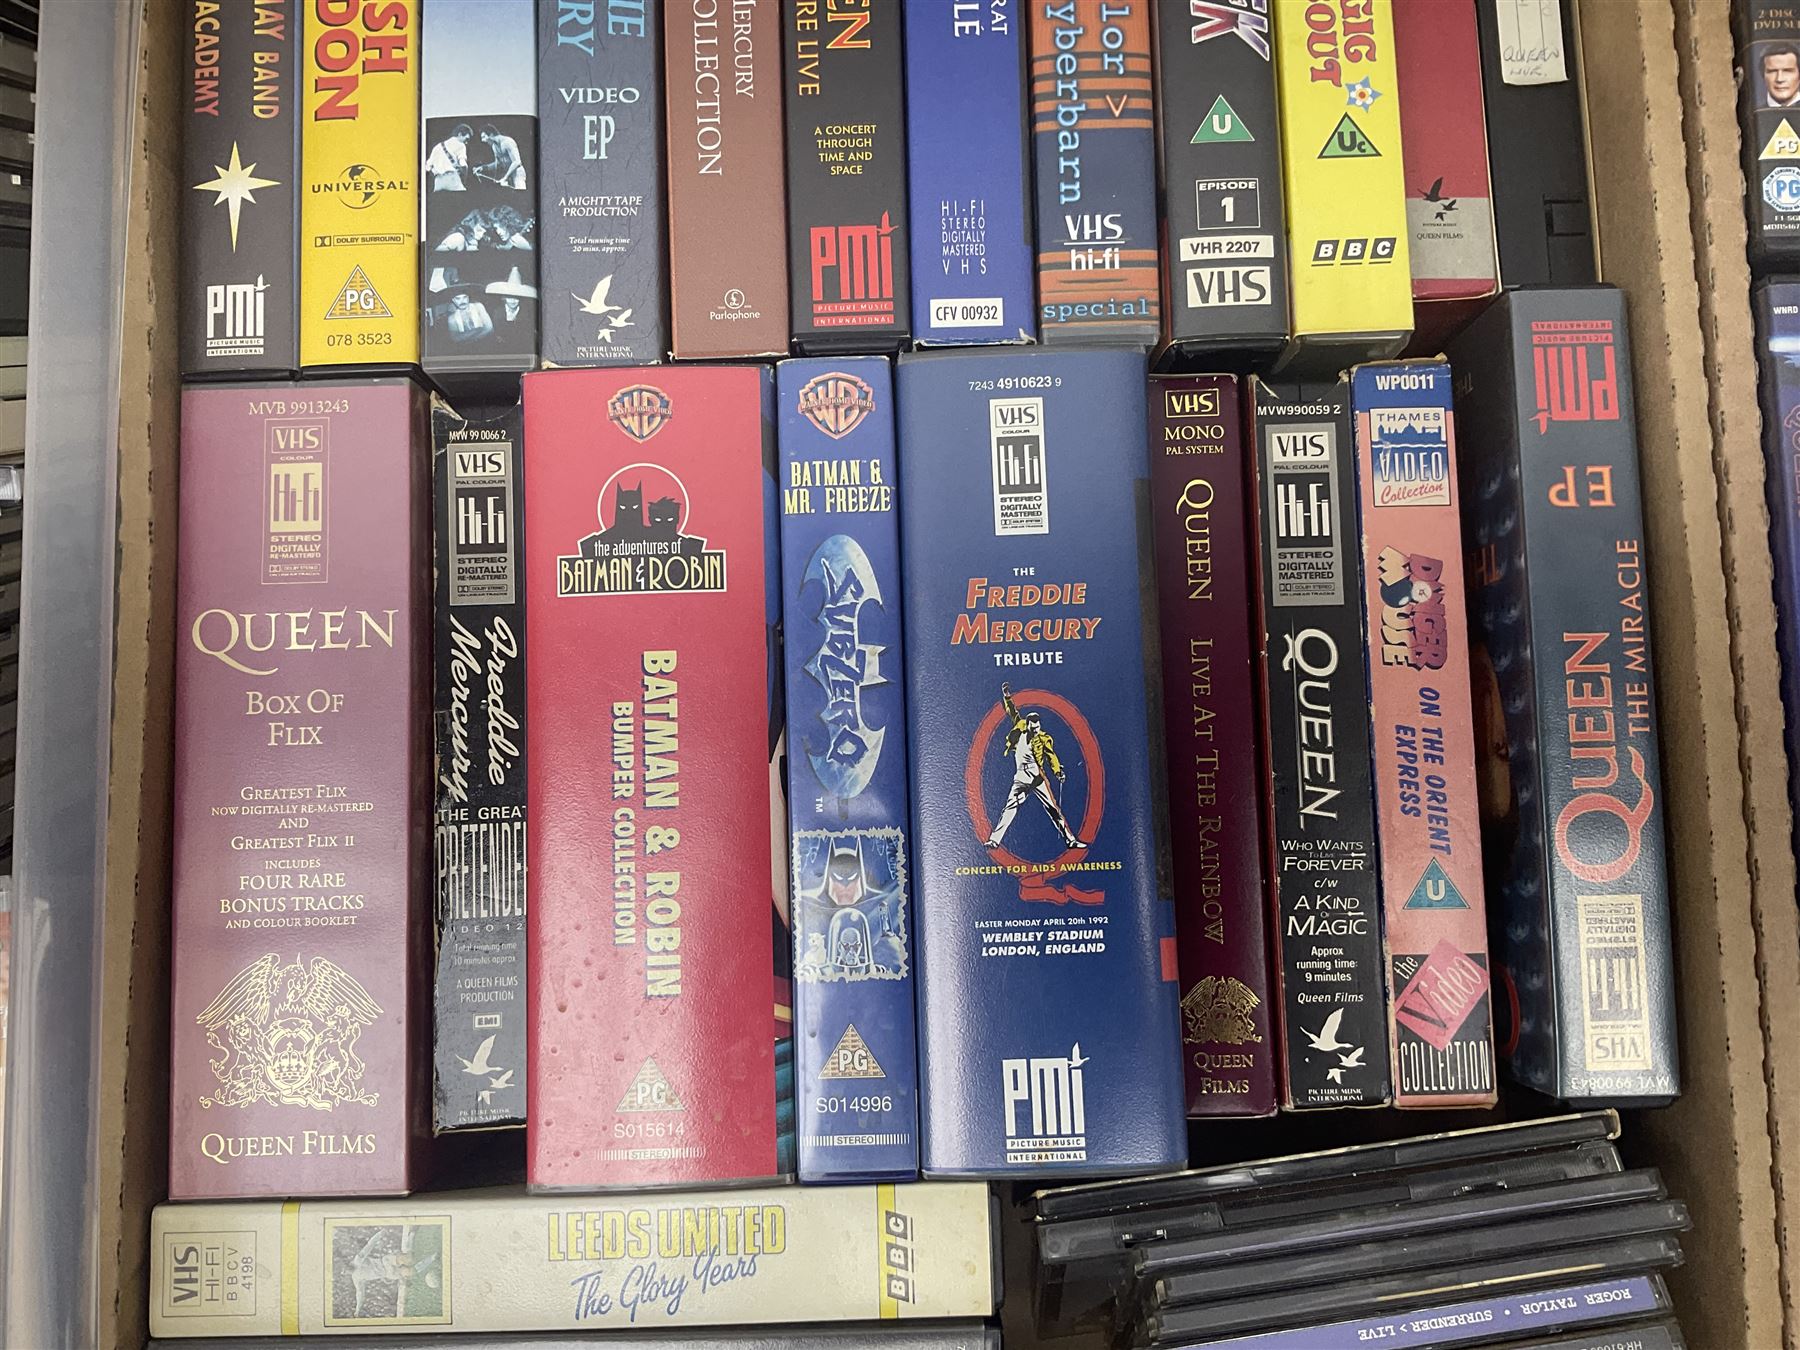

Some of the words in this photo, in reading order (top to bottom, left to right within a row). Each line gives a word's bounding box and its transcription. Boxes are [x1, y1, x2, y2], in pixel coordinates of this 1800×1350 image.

[194, 1, 220, 117] ACADEMY
[797, 40, 820, 96] LIVE
[253, 52, 280, 119] BAND
[558, 88, 640, 103] VIDEO
[814, 126, 822, 136] A
[826, 125, 877, 135] CONCERT
[1212, 114, 1232, 134] U
[583, 115, 616, 160] EP
[817, 138, 872, 148] THROUGH
[819, 152, 844, 162] TIME
[848, 152, 872, 161] AND
[830, 165, 863, 175] SPACE
[312, 180, 408, 194] UNIVERSAL
[1198, 182, 1256, 191] EPISODE
[559, 197, 567, 206] A
[567, 196, 613, 206] MIGHTY
[614, 196, 643, 206] TAPE
[941, 200, 984, 216] HI-FI
[1220, 196, 1235, 223] 1
[563, 206, 638, 217] PRODUCTION
[941, 217, 985, 230] STEREO
[1065, 214, 1123, 241] VHS
[942, 230, 985, 242] DIGITALLY
[942, 244, 986, 256] MASTERED
[1190, 242, 1222, 255] VHR
[1226, 241, 1260, 254] 2207
[1070, 247, 1120, 271] hi-fi
[345, 289, 375, 311] PG
[710, 310, 760, 322] Parlophone
[936, 307, 958, 321] CFV
[961, 306, 998, 320] 00932
[1043, 298, 1149, 322] special
[327, 335, 353, 347] 078
[357, 333, 392, 345] 3523
[968, 381, 994, 391] 7243
[996, 376, 1052, 389] 4910623
[1055, 378, 1062, 387] 9
[1376, 374, 1434, 391] WP0011
[249, 402, 286, 415] MVB
[290, 399, 350, 414] 9913243
[1170, 393, 1214, 414] VHS
[1377, 412, 1441, 422] THAMES
[1164, 425, 1225, 441] MONO
[1166, 446, 1184, 455] PAL
[1185, 445, 1224, 455] SYSTEM
[790, 460, 861, 487] BATMAN
[1379, 451, 1443, 482] VIDEO
[1380, 482, 1444, 505] Collection
[1548, 465, 1616, 508] EP
[784, 488, 816, 515] MR.
[825, 486, 891, 513] FREEZE
[594, 540, 610, 557] the
[612, 539, 669, 556] adventures
[671, 538, 682, 554] of
[1176, 478, 1214, 601] QUEEN
[560, 557, 632, 593] BATMAN
[635, 557, 645, 590] &
[648, 555, 721, 590] ROBIN
[1013, 567, 1035, 576] THE
[966, 578, 1087, 609] FREDDIE
[1616, 539, 1648, 673] MIRACLE
[950, 612, 1102, 645] MERCURY
[192, 606, 399, 676] QUEEN
[994, 651, 1063, 667] TRIBUTE
[1190, 637, 1214, 698] LIVE
[440, 613, 482, 803] Mercury
[484, 616, 520, 786] Freddie
[1418, 686, 1442, 718] ON
[1628, 681, 1650, 738] THE
[642, 650, 680, 809] BATMAN
[1193, 703, 1217, 742] AT
[1282, 628, 1343, 821] QUEEN
[612, 701, 635, 800] BUMPER
[1421, 727, 1445, 766] THE
[1554, 631, 1654, 883] QUEEN
[1195, 748, 1220, 808] THE
[1395, 724, 1422, 818] EXPRESS
[240, 786, 312, 800] GREATEST
[316, 785, 347, 798] FLIX
[211, 806, 239, 816] NOW
[241, 805, 298, 815] DIGITALLY
[301, 802, 374, 813] RE-MASTERED
[1424, 774, 1452, 856] ORIENT
[278, 818, 309, 829] AND
[231, 836, 303, 850] GREATEST
[307, 834, 337, 848] FLIX
[345, 836, 355, 847] II
[645, 824, 681, 855] &
[1281, 840, 1313, 851] WHO
[1316, 840, 1364, 850] WANTS
[265, 859, 321, 870] INCLUDES
[955, 866, 1003, 876] CONCERT
[1007, 865, 1027, 874] FOR
[1031, 864, 1056, 872] AIDS
[1060, 861, 1122, 871] AWARENESS
[1284, 856, 1364, 871] FOREVER
[239, 874, 293, 890] FOUR
[299, 873, 346, 888] RARE
[612, 807, 636, 945] COLLECTION
[1199, 815, 1224, 946] RAINBOW
[220, 897, 286, 914] BONUS
[291, 895, 364, 912] TRACKS
[1294, 895, 1310, 910] A
[1316, 894, 1360, 910] KIND
[975, 921, 1003, 929] EASTER
[1004, 919, 1041, 928] MONDAY
[1286, 915, 1368, 936] MAGIC
[645, 871, 682, 998] ROBIN
[982, 931, 1043, 943] WEMBLEY
[1047, 929, 1104, 941] STADIUM
[981, 945, 1041, 957] LONDON,
[1045, 942, 1106, 954] ENGLAND
[1311, 946, 1344, 957] Approx
[1296, 960, 1331, 970] running
[1334, 959, 1358, 969] time:
[1305, 973, 1313, 982] 9
[1314, 972, 1352, 982] minutes
[1297, 992, 1331, 1004] Queen
[1334, 992, 1364, 1003] Films
[477, 1017, 498, 1026] EMI
[837, 1048, 868, 1072] PG
[1194, 1052, 1254, 1073] QUEEN
[1200, 1076, 1250, 1094] FILMS
[815, 1096, 892, 1113] S014996
[614, 1123, 685, 1138] S015614
[201, 1133, 295, 1164] QUEEN
[302, 1130, 376, 1156] FILMS
[836, 1136, 874, 1145] STEREO
[548, 1209, 651, 1262] LEEDS
[657, 1205, 786, 1258] UNITED
[173, 1246, 199, 1303] VHS
[205, 1247, 220, 1302] HI-FI
[242, 1256, 253, 1290] 4198
[571, 1270, 612, 1321] The
[620, 1261, 689, 1322] Glory
[693, 1244, 759, 1294] Years
[1520, 1296, 1576, 1315] TAYLOR
[1584, 1288, 1632, 1304] ROGER
[1409, 1309, 1493, 1333] SURRENDER
[1357, 1324, 1396, 1341] LIVE
